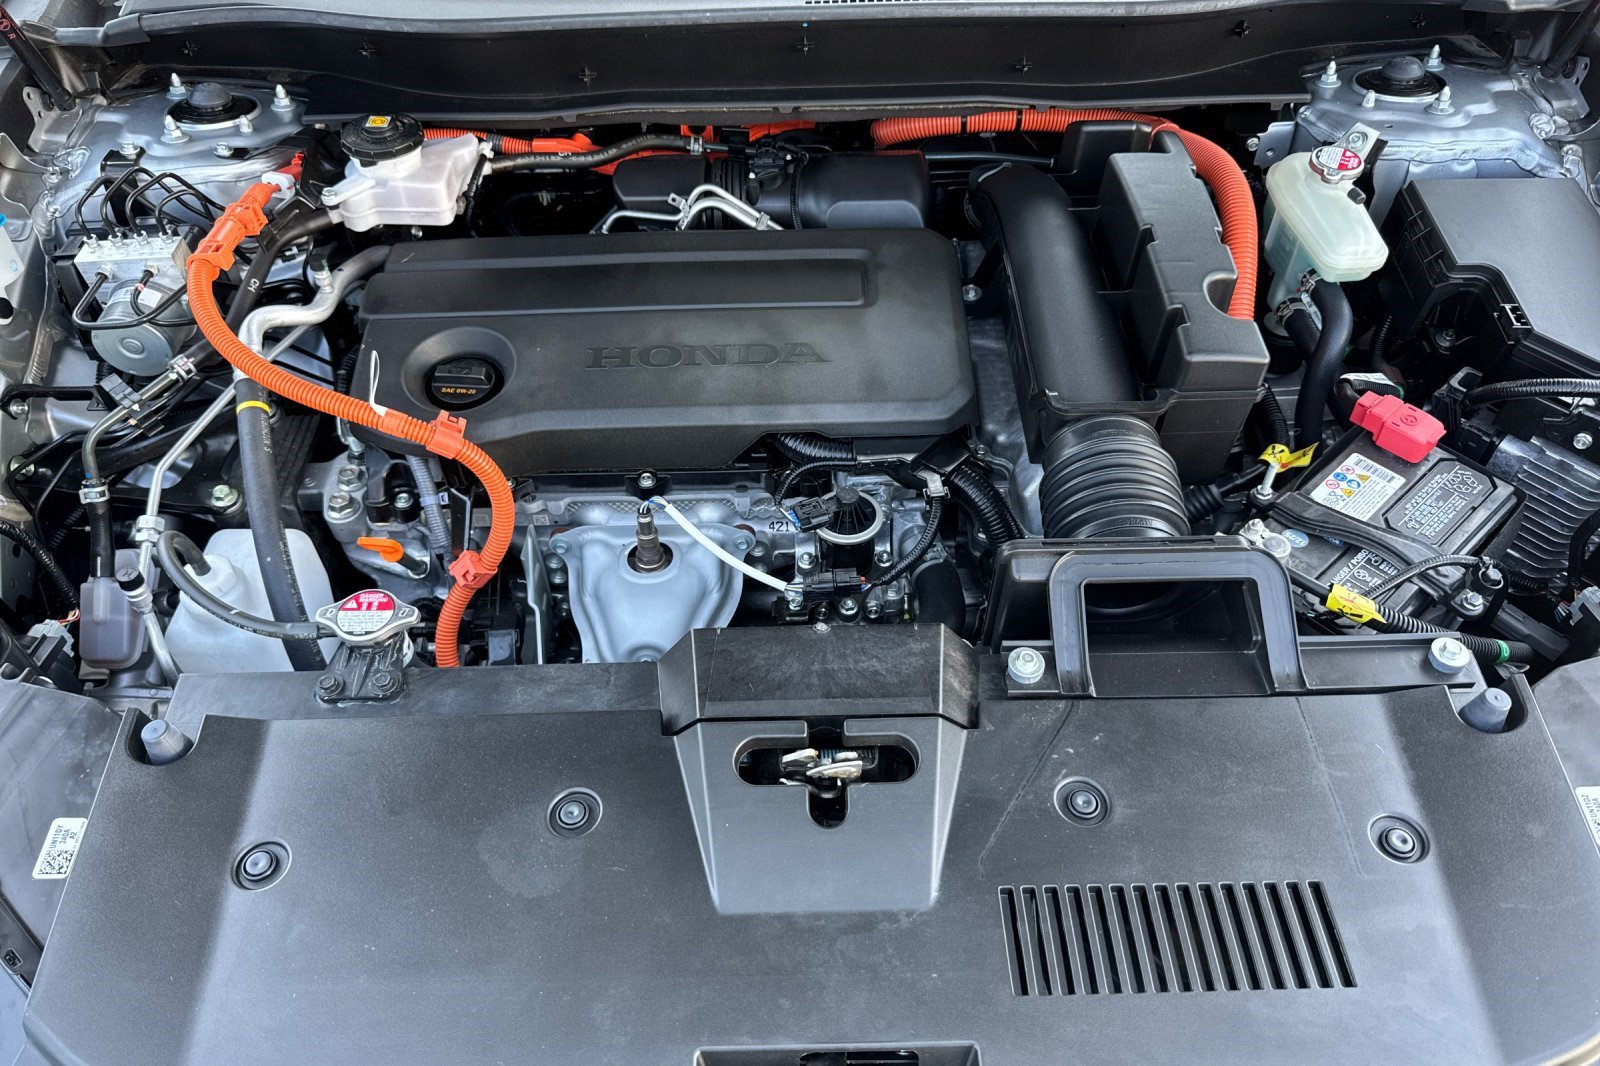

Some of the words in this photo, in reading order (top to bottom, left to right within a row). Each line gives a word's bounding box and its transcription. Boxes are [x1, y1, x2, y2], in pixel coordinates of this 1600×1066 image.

[247, 278, 260, 293] CH
[585, 342, 833, 370] HONDA
[768, 521, 790, 532] 421
[1283, 531, 1307, 547] 12/25
[1351, 549, 1369, 566] POISO
